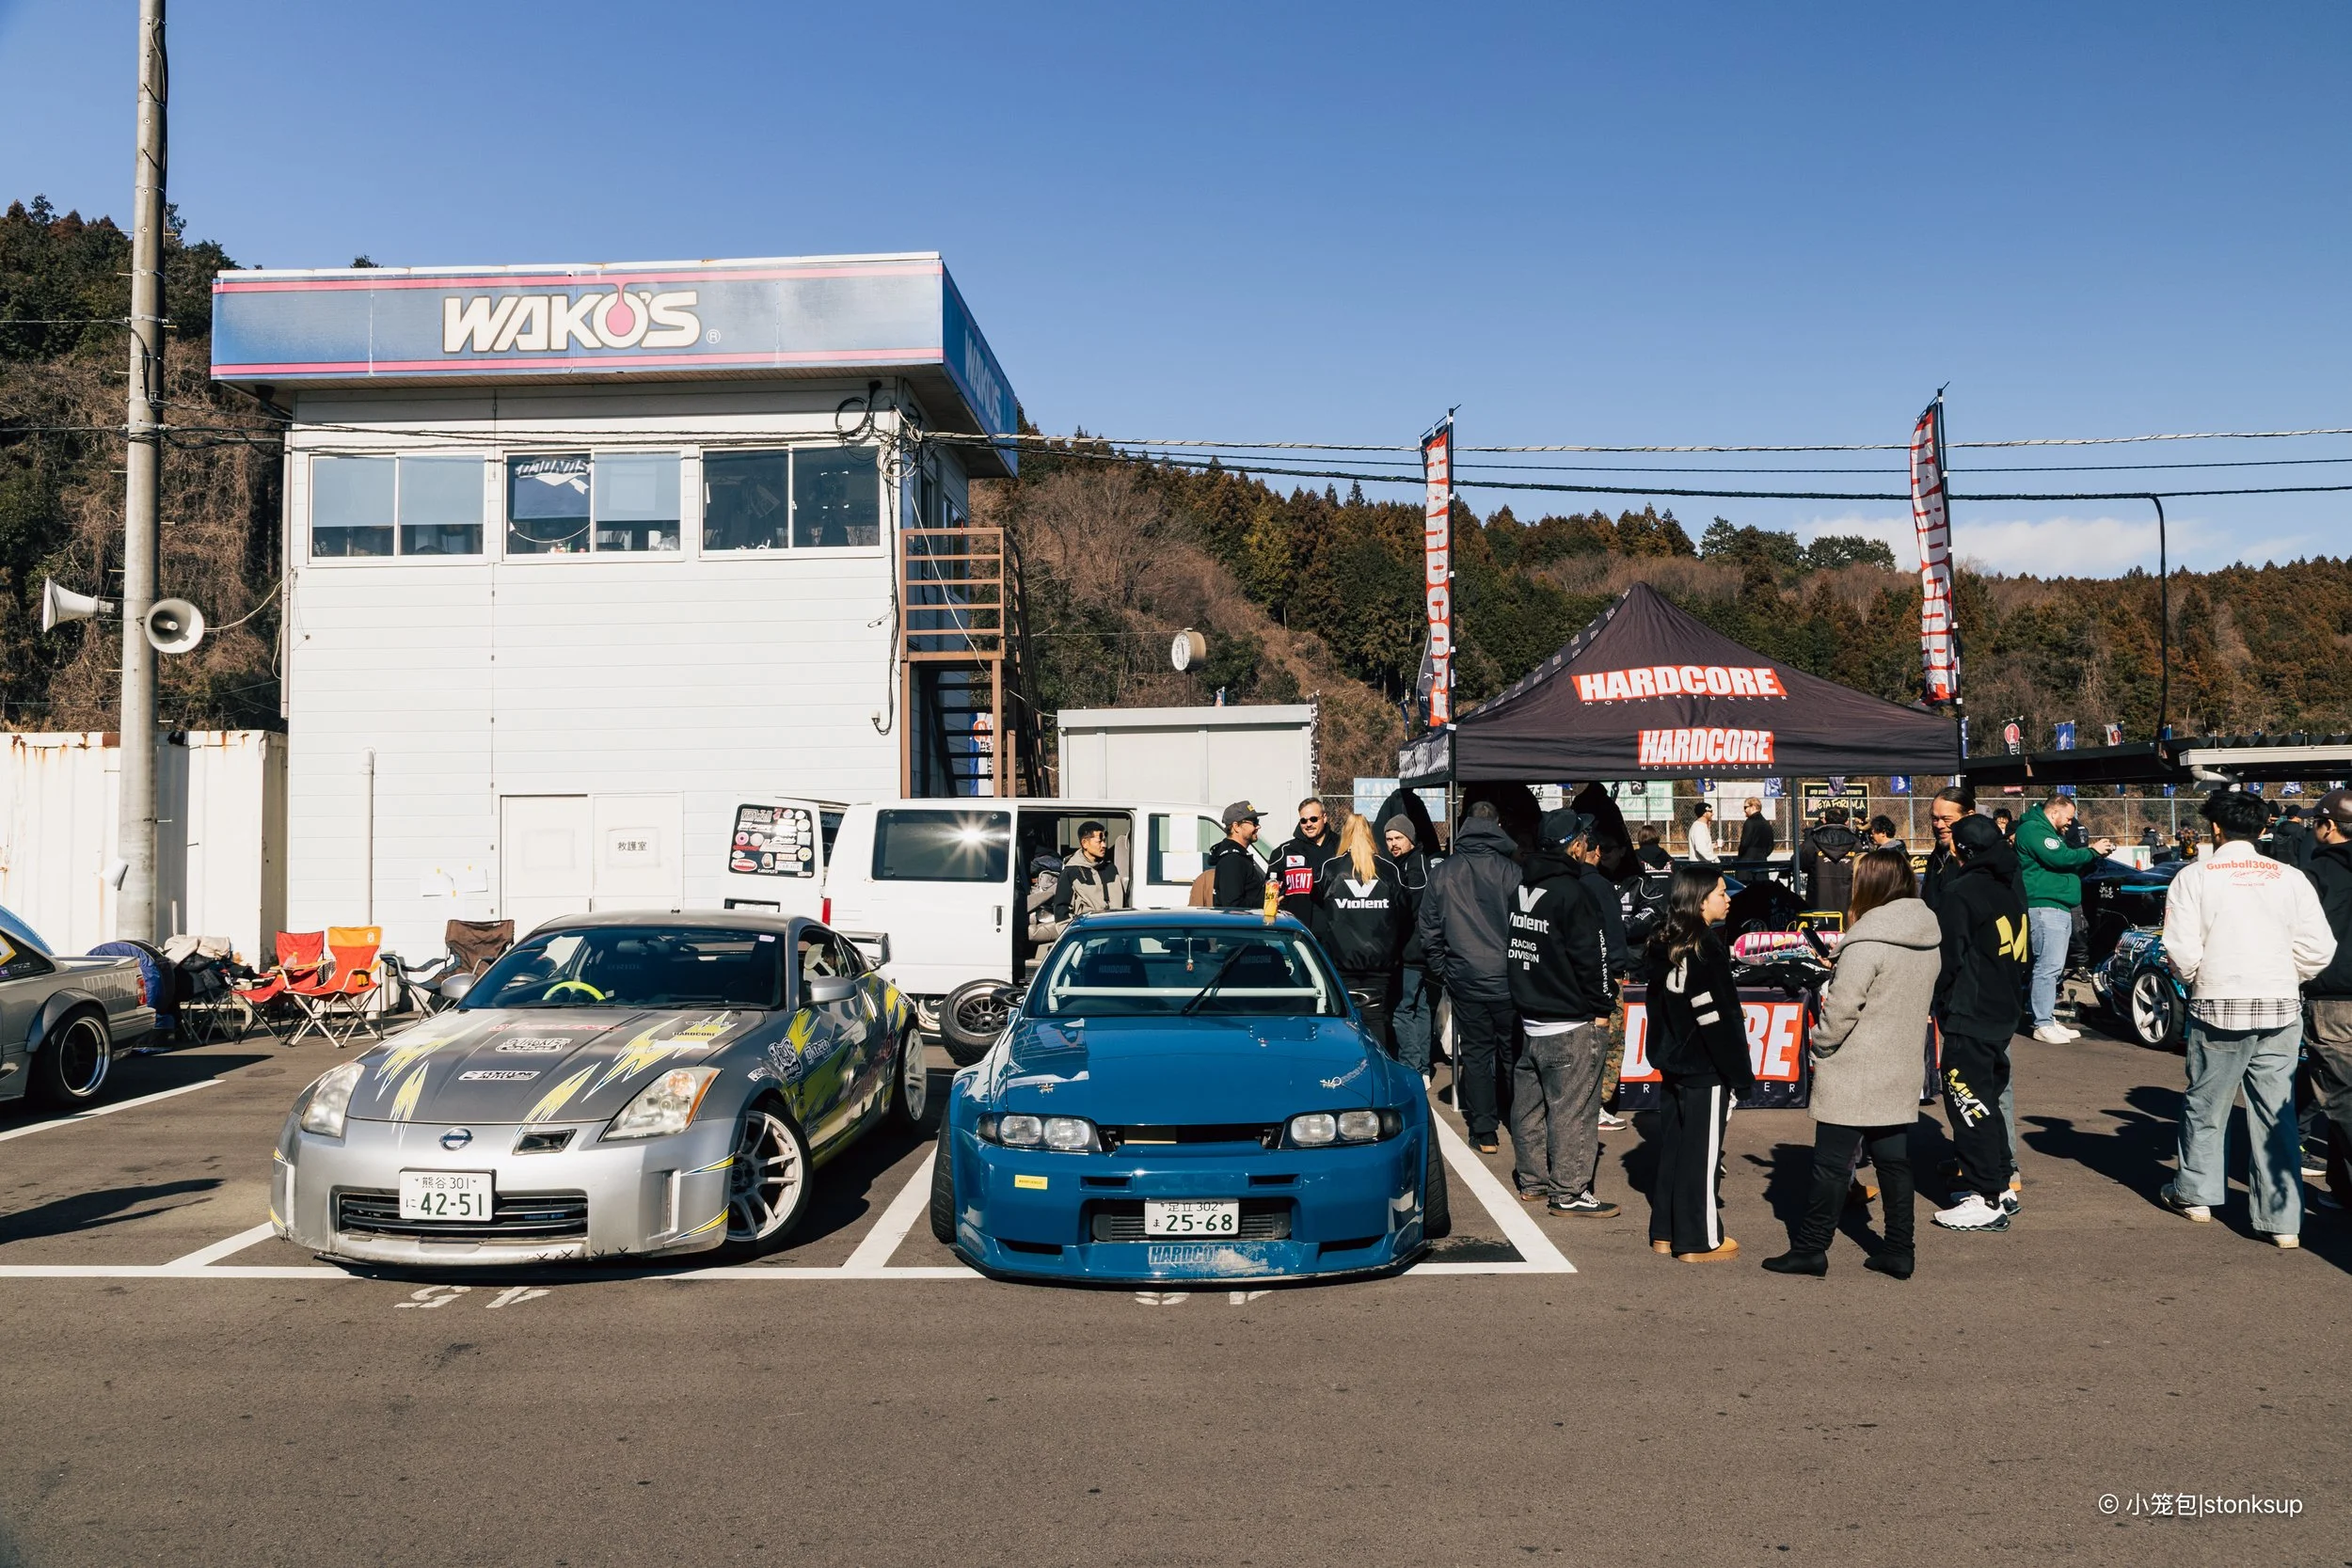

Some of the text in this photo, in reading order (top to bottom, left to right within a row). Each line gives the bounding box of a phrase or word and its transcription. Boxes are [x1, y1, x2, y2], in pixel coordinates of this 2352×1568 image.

[443, 291, 701, 353] WAKO'S
[1579, 665, 1778, 701] HARDCORE
[1584, 694, 1788, 705] MOTHERFUCKER
[1640, 728, 1772, 764] HARDCORE
[617, 841, 647, 851] 救護室
[2206, 860, 2279, 871] Gumball3000
[1334, 898, 1390, 910] Violent
[421, 1177, 469, 1190] 熊谷 301
[405, 1192, 483, 1217] に 42-51
[1168, 1201, 1218, 1212] 足立 302
[1152, 1213, 1233, 1232] ま 25-68
